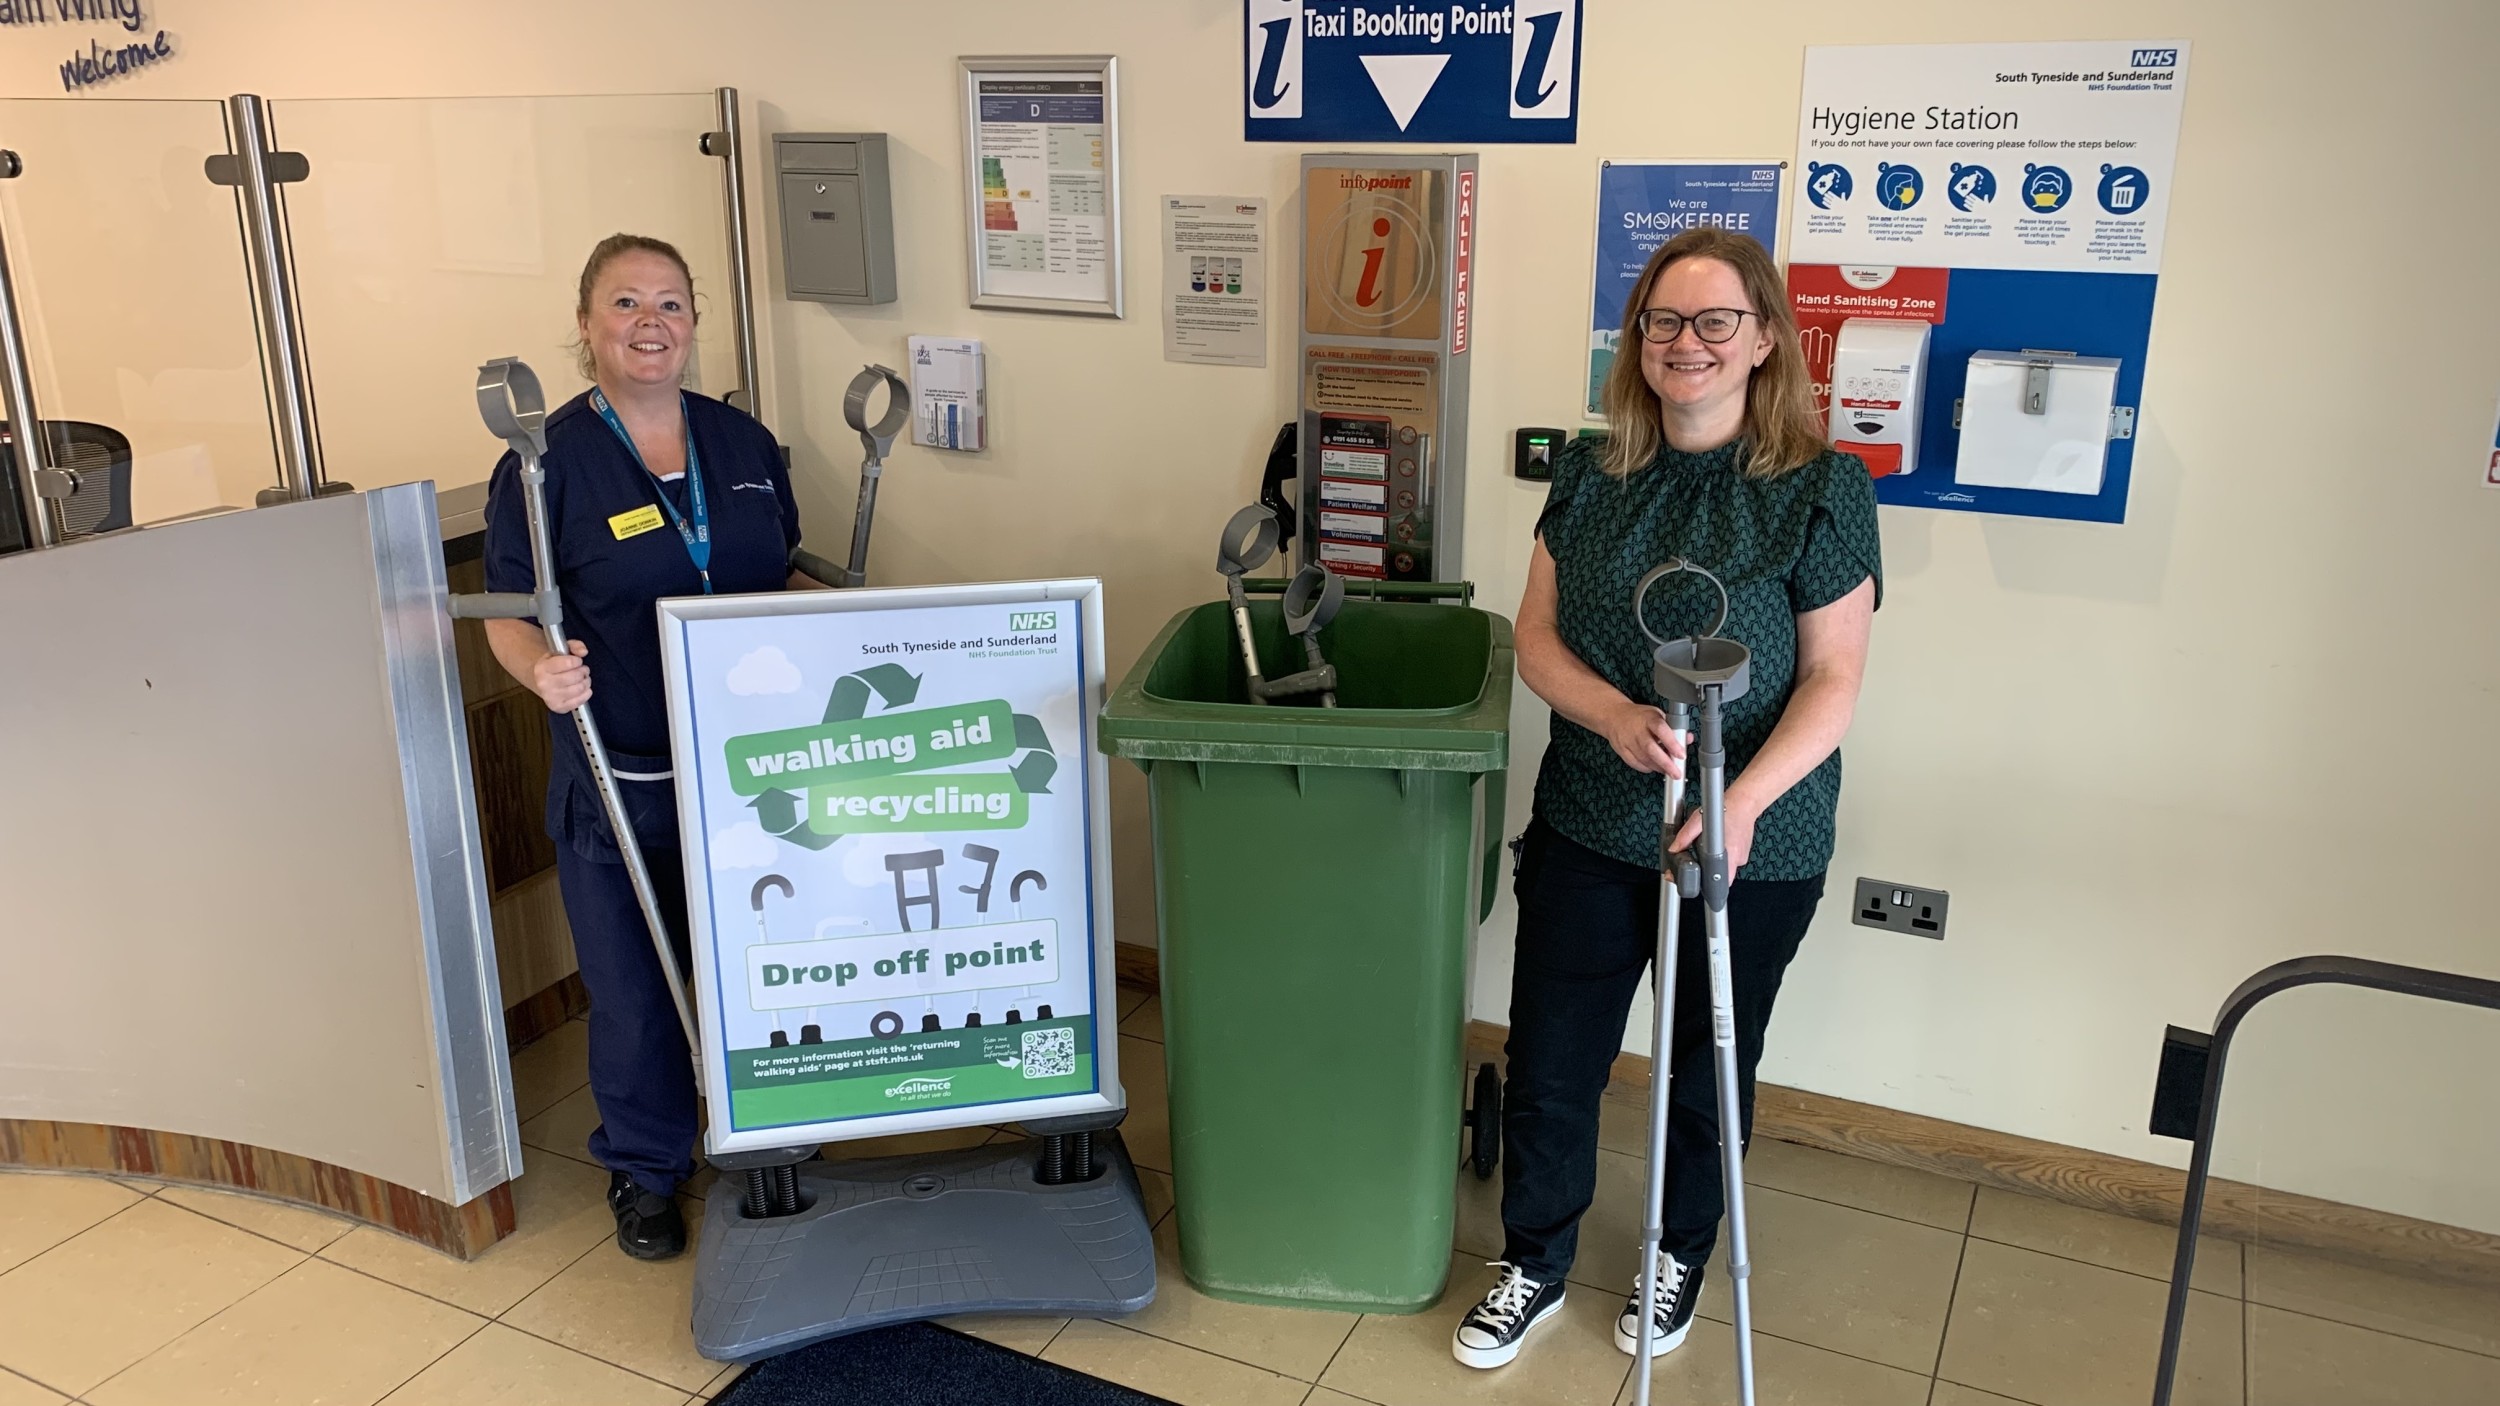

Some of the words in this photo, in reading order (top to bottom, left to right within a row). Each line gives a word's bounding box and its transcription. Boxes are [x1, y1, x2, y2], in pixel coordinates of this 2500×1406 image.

[1304, 7, 1346, 37] Taxi
[1353, 5, 1444, 43] Booking
[1451, 4, 1512, 35] Point
[60, 30, 170, 92] Welcome
[2133, 51, 2176, 66] NHS
[1996, 73, 2028, 82] South
[2031, 72, 2079, 84] Tyneside
[2082, 71, 2104, 81] and
[2107, 71, 2174, 81] Sunderland
[2107, 83, 2151, 91] Foundation
[1030, 104, 1040, 117] D
[1812, 106, 1915, 135] Hygiene
[1925, 106, 2018, 130] Station
[1811, 139, 1819, 147] If
[1819, 141, 1835, 149] you
[1838, 139, 1849, 147] do
[1891, 141, 1911, 149] your
[1935, 139, 1953, 148] face
[1955, 140, 1994, 149] covering
[1996, 140, 2025, 149] please
[2028, 139, 2058, 148] follow
[2060, 139, 2076, 148] the
[2078, 141, 2102, 149] steps
[2104, 140, 2137, 148] below:
[1340, 174, 1412, 191] infopoint
[1752, 171, 1774, 179] NHS
[1668, 199, 1687, 209] We
[1689, 200, 1708, 209] are
[1459, 180, 1471, 257] CALL
[1631, 231, 1670, 242] Smoking
[1456, 271, 1467, 346] FREE
[1796, 294, 1830, 305] Hand
[1833, 295, 1898, 309] Sanitising
[1902, 297, 1936, 308] Zone
[1873, 309, 1895, 317] spread
[1309, 350, 1326, 358] CALL
[1328, 351, 1344, 359] FREE
[1398, 355, 1416, 363] CALL
[1418, 356, 1435, 364] FREE
[1811, 382, 1832, 396] OP
[1351, 502, 1377, 510] Welfare
[698, 525, 708, 542] NHS
[1331, 531, 1372, 542] Volunteering
[1326, 561, 1347, 570] Parking
[1353, 563, 1376, 573] Security
[1011, 613, 1055, 630] NHS
[862, 643, 899, 654] South
[902, 640, 956, 654] Tyneside
[960, 638, 983, 649] and
[987, 634, 1057, 648] Sunderland
[969, 651, 987, 659] NHS
[989, 649, 1035, 658] Foundation
[745, 734, 917, 777] walking
[930, 715, 992, 751] aid
[827, 786, 1011, 822] recycling
[762, 962, 858, 987] Drop
[873, 948, 930, 976] off
[945, 939, 1045, 976] point
[753, 1058, 770, 1068] For
[772, 1056, 800, 1066] more
[802, 1049, 863, 1063] information
[866, 1046, 888, 1057] visit
[890, 1044, 907, 1054] the
[754, 1065, 795, 1078] walking
[824, 1061, 849, 1073] page
[852, 1059, 863, 1068] at
[865, 1053, 923, 1066] stsft.nhs.uk
[885, 1081, 951, 1098] excellence
[917, 1092, 930, 1100] that
[942, 1090, 951, 1098] do
